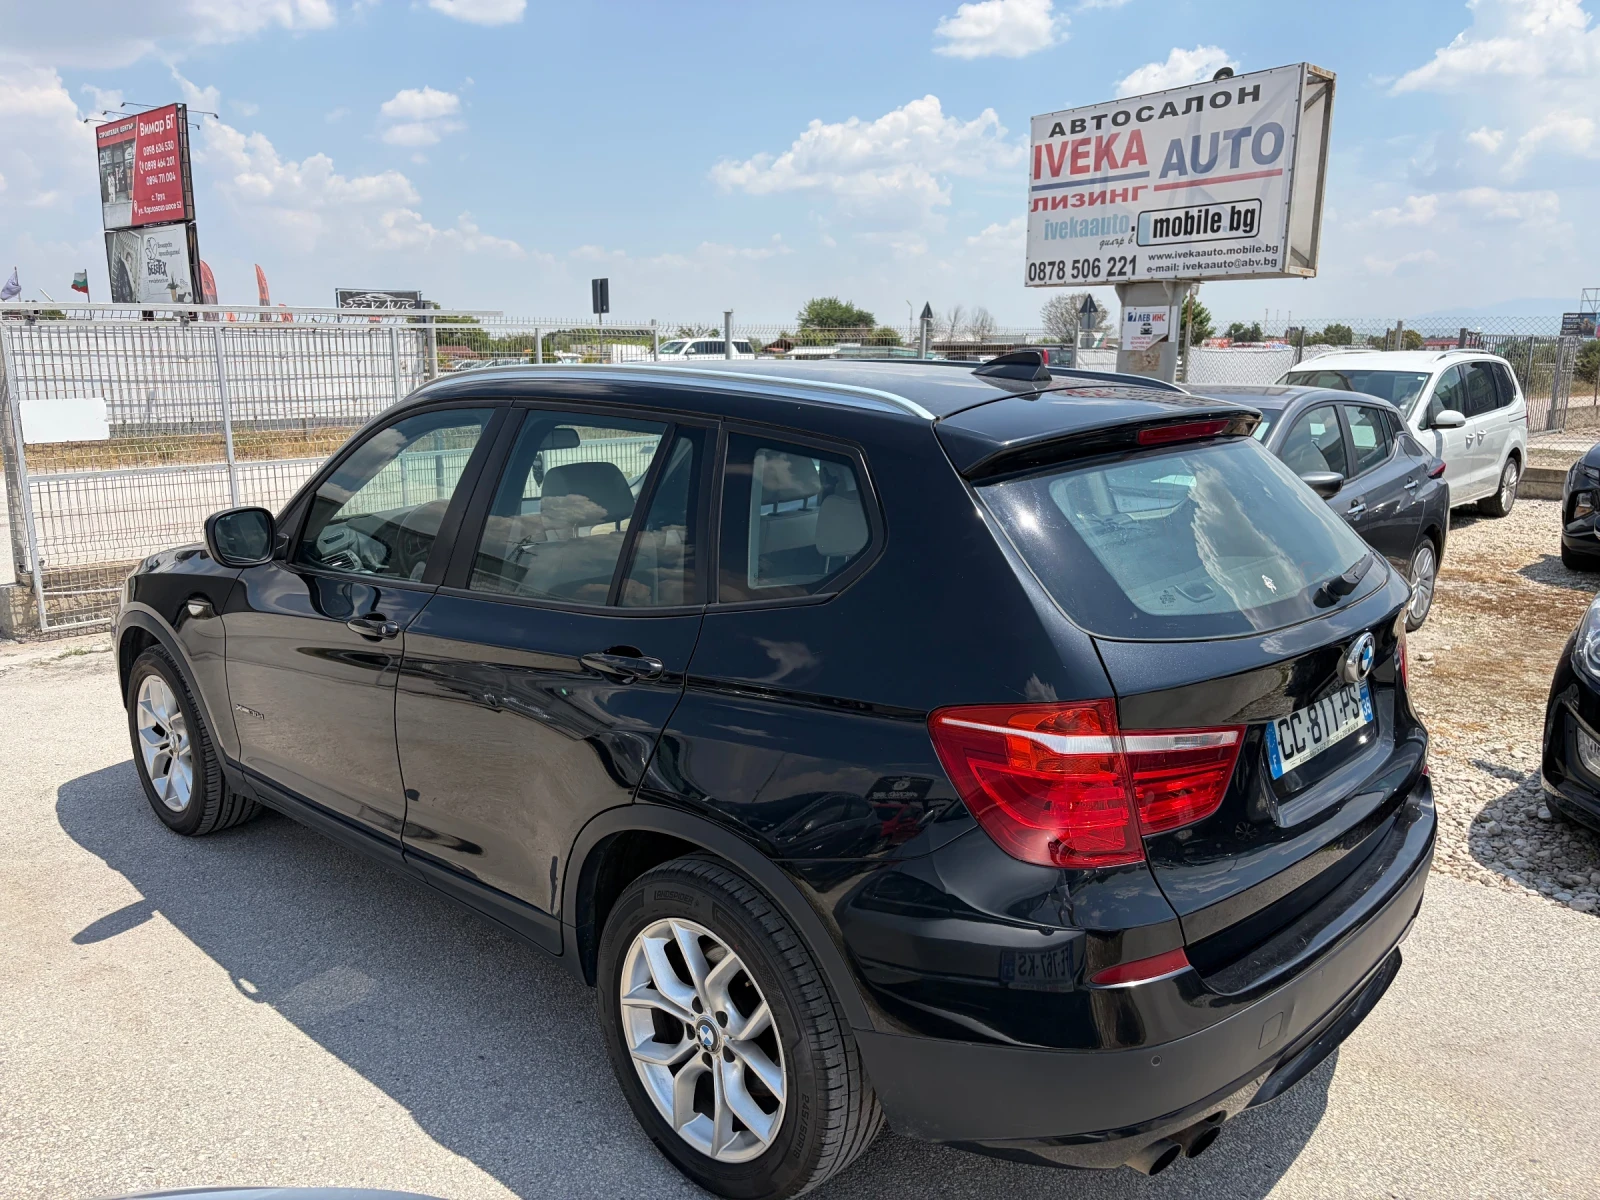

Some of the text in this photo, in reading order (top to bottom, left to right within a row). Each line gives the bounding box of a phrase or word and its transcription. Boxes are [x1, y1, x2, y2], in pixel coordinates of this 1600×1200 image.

[165, 114, 175, 129] БГ
[1048, 84, 1260, 138] АВТОСАЛОН
[1033, 121, 1285, 180] IVEKA AUTO
[1030, 185, 1149, 212] ЛИЗИНГ
[1148, 244, 1279, 261] www.ivekaauto.mobile.bg
[1028, 254, 1137, 281] 0878 506 221
[1146, 257, 1278, 273] e-mail: ivekaauto@abv.bg
[1138, 313, 1166, 322] ЛЕВ ИНС
